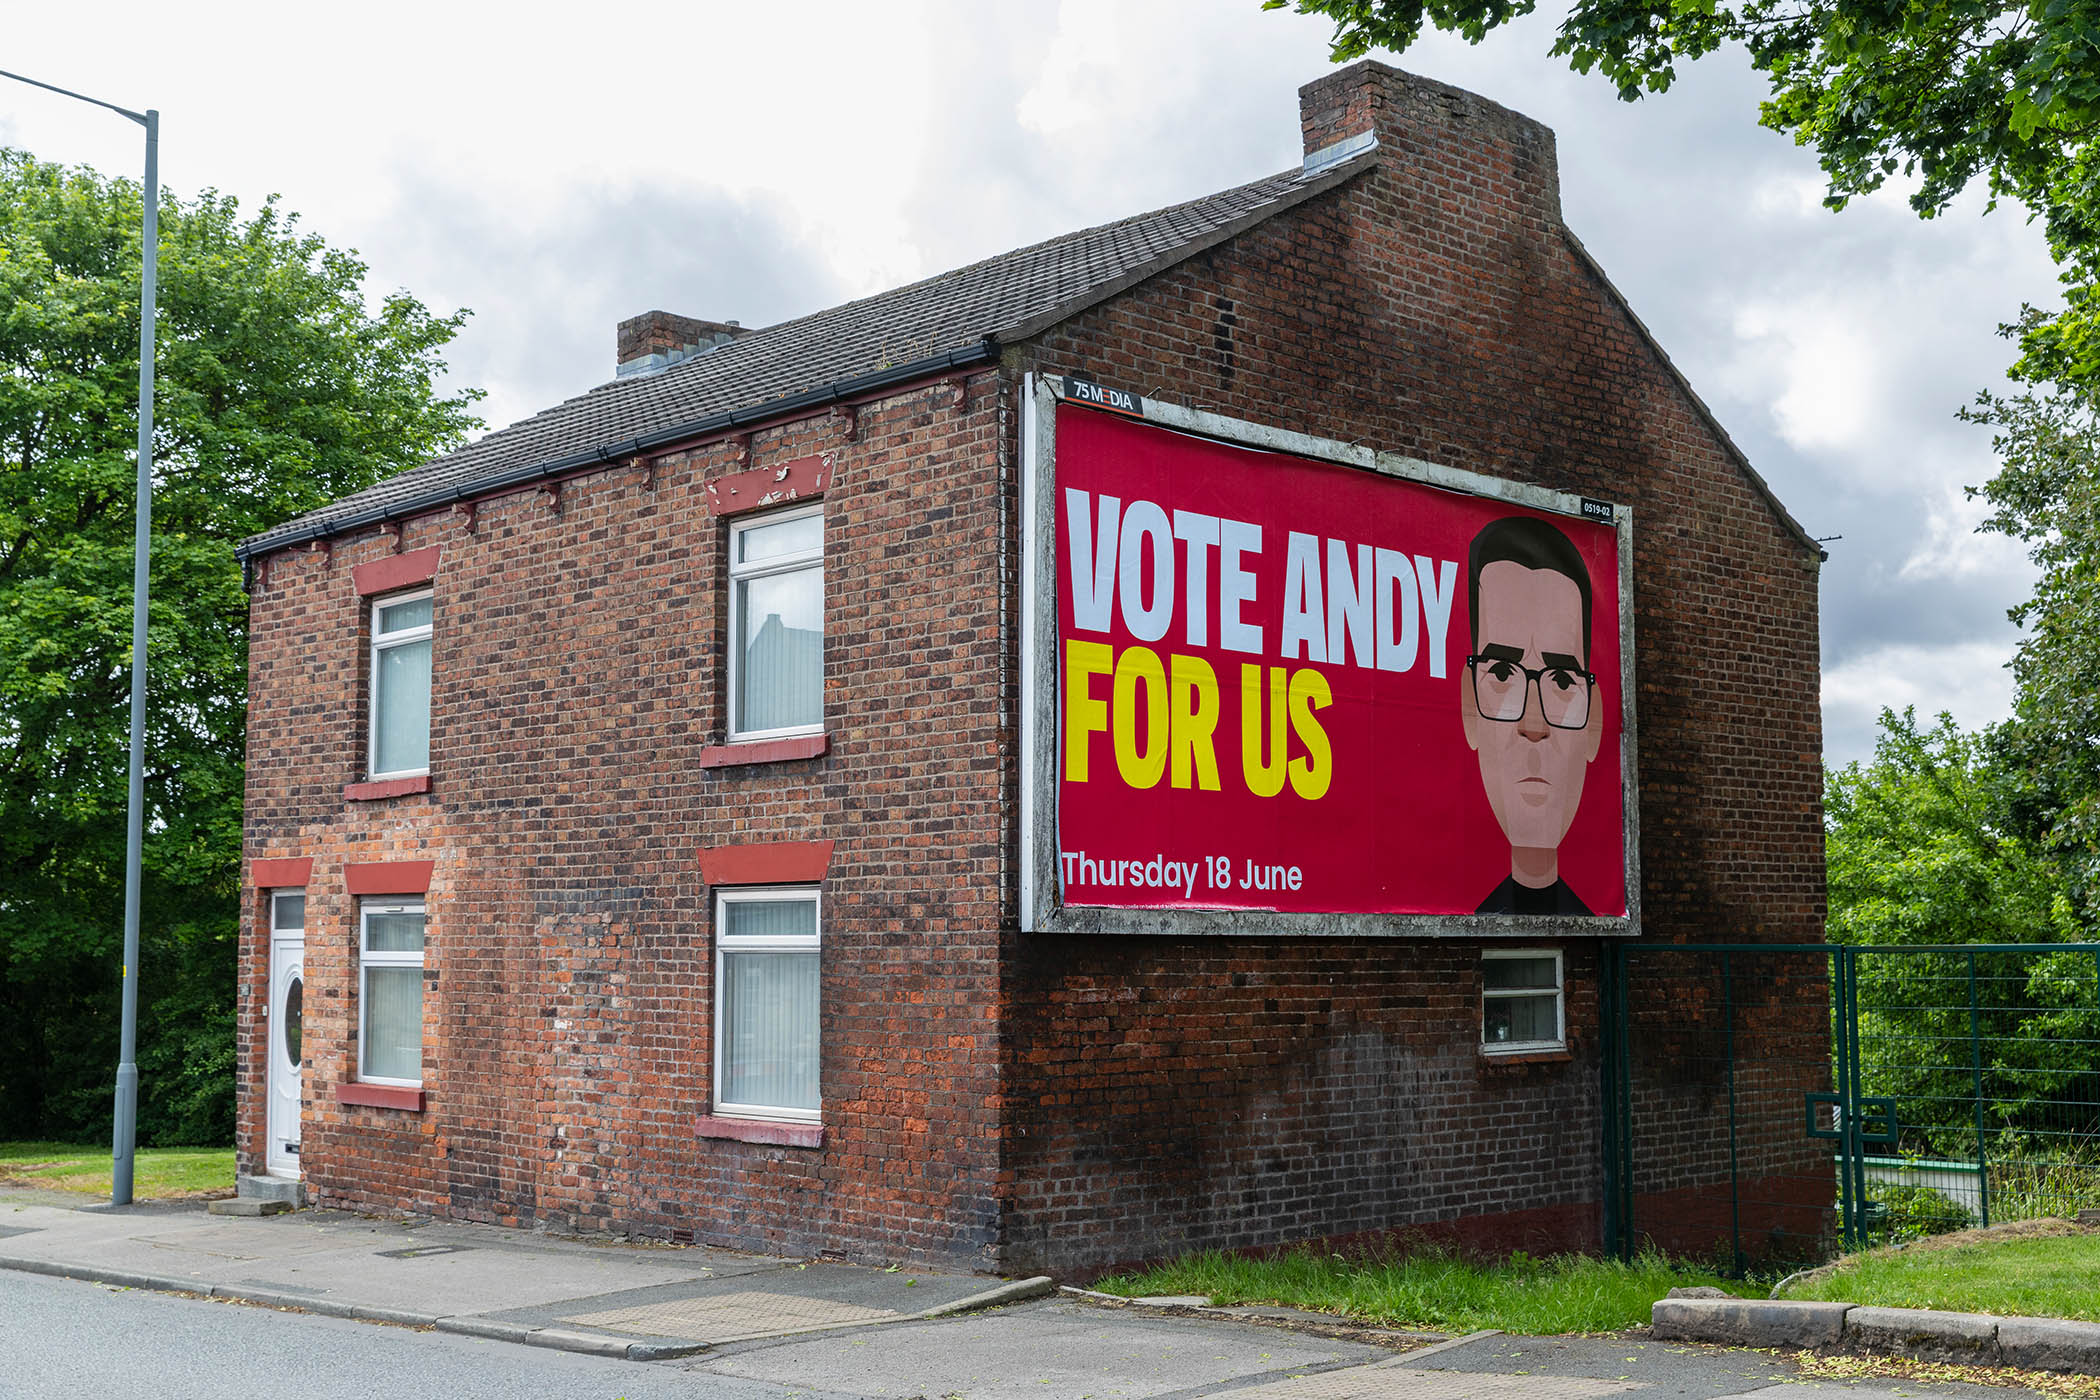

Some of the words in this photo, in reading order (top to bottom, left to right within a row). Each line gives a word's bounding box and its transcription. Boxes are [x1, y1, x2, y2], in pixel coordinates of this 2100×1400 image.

[1584, 503, 1610, 516] 0519-02
[1065, 487, 1263, 655] VOTE
[1281, 531, 1459, 679] ANDY
[1066, 639, 1221, 791] FOR
[1241, 663, 1333, 800] US
[1062, 851, 1198, 899] Thursday
[1205, 856, 1231, 889] 18
[1239, 859, 1303, 890] June
